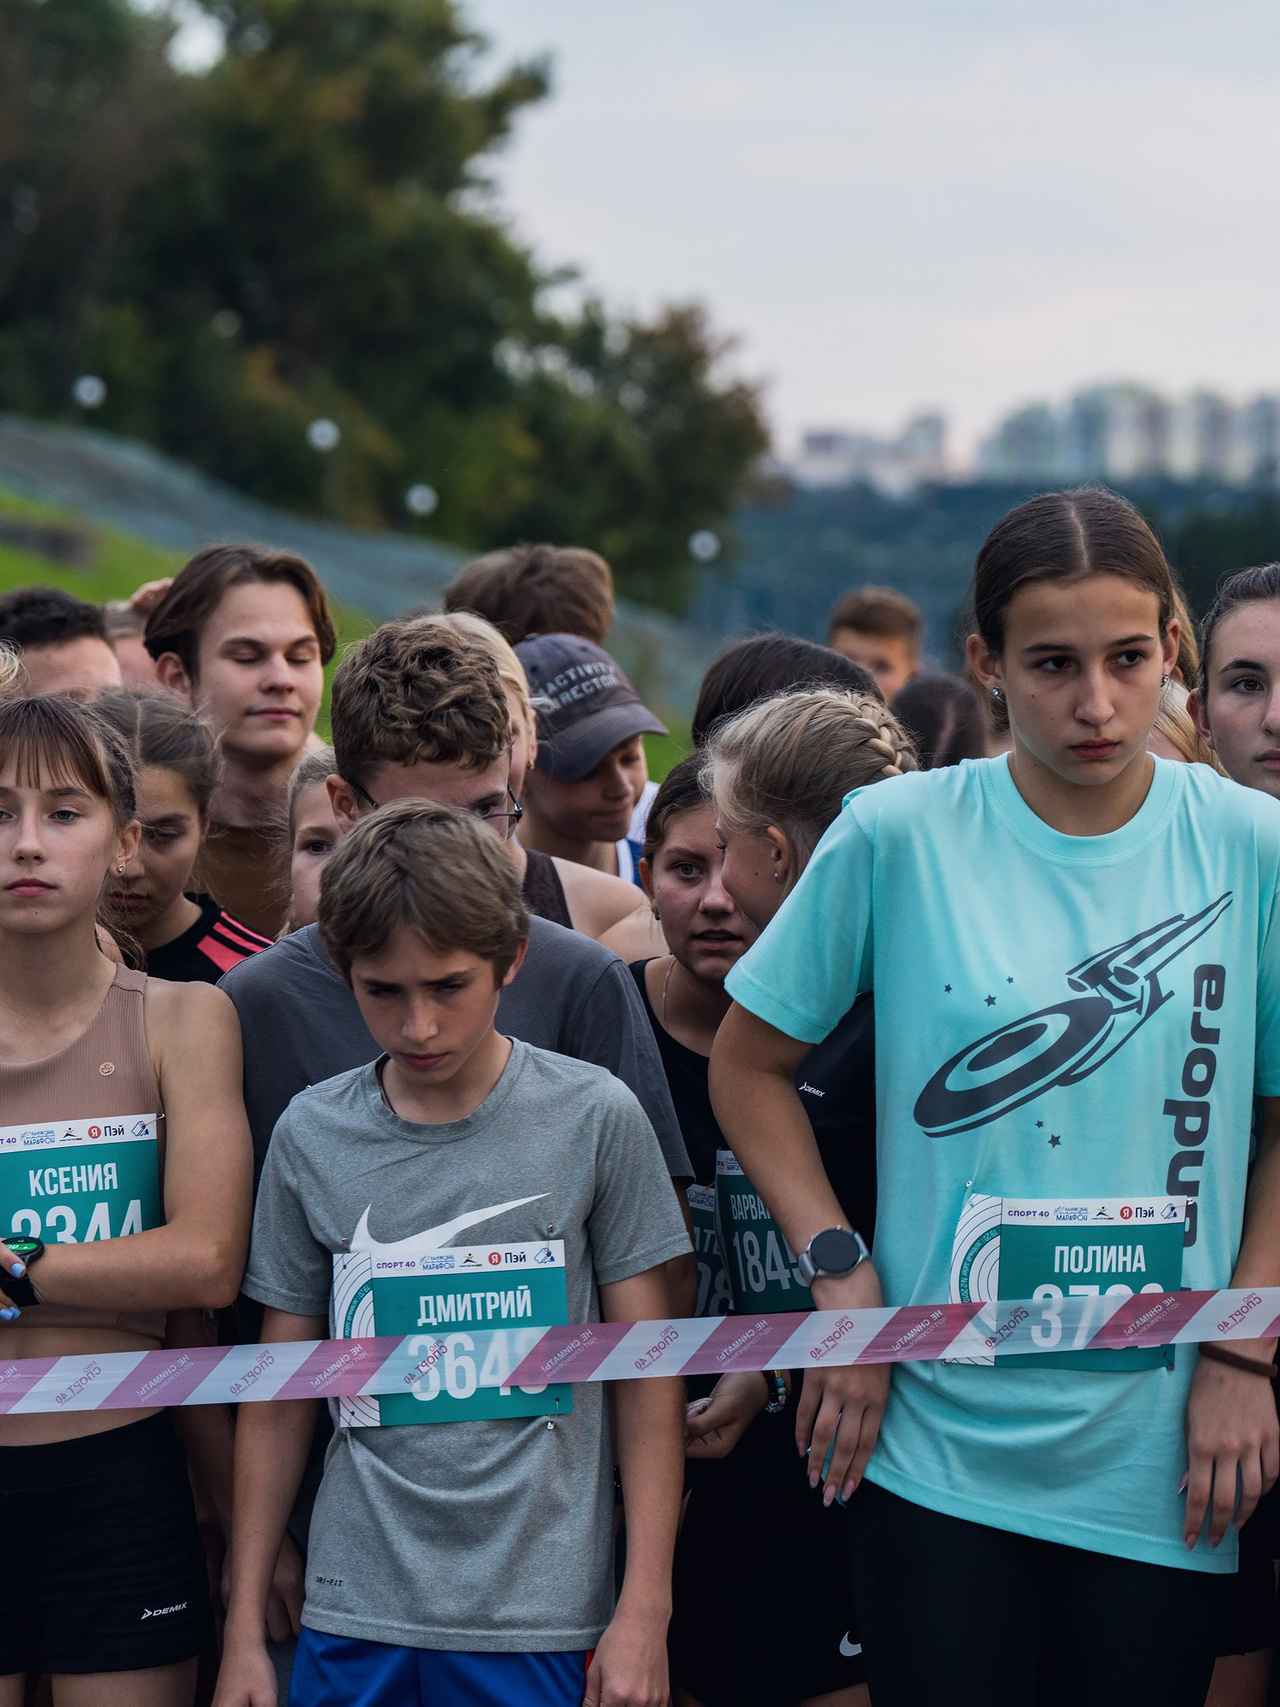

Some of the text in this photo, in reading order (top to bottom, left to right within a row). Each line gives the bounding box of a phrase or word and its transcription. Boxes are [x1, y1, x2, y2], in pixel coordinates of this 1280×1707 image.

[104, 1125, 125, 1137] Пэй
[28, 1162, 118, 1197] КСЕНИЯ
[1038, 1210, 1050, 1218] 40
[1135, 1206, 1155, 1219] Пэй
[504, 1251, 526, 1264] Пэй
[1054, 1244, 1146, 1274] ПОЛИНА
[376, 1261, 404, 1269] СПОРТ
[417, 1285, 532, 1326] ДМИТРИЙ
[152, 1602, 188, 1616] DEMIX
